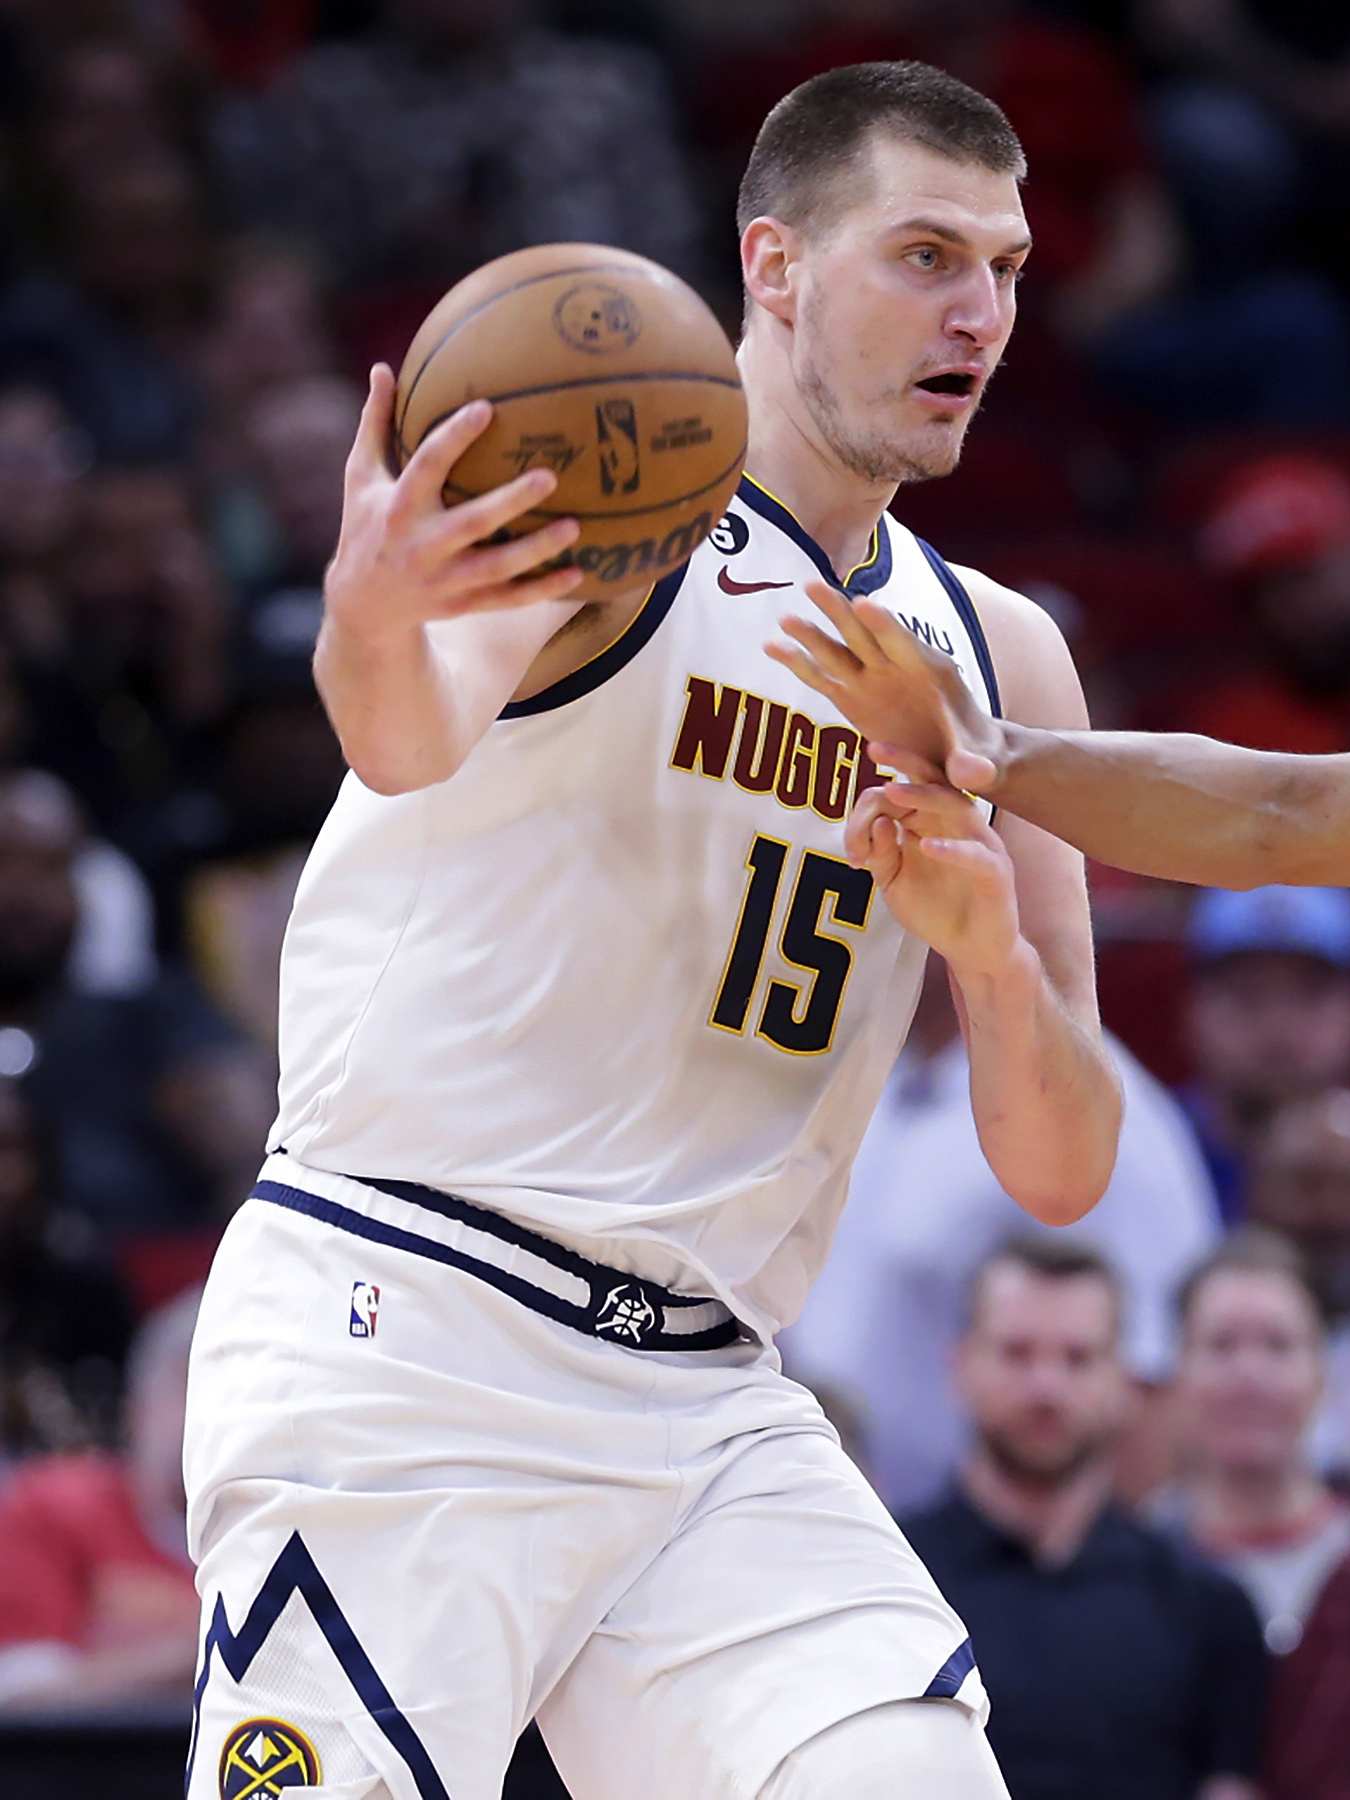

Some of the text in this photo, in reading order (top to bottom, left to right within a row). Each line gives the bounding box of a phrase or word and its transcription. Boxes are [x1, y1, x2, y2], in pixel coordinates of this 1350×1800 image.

[546, 510, 712, 583] Wils
[710, 517, 736, 550] 6
[897, 612, 955, 656] WU
[670, 675, 896, 823] NUGG
[707, 831, 877, 1055] 15
